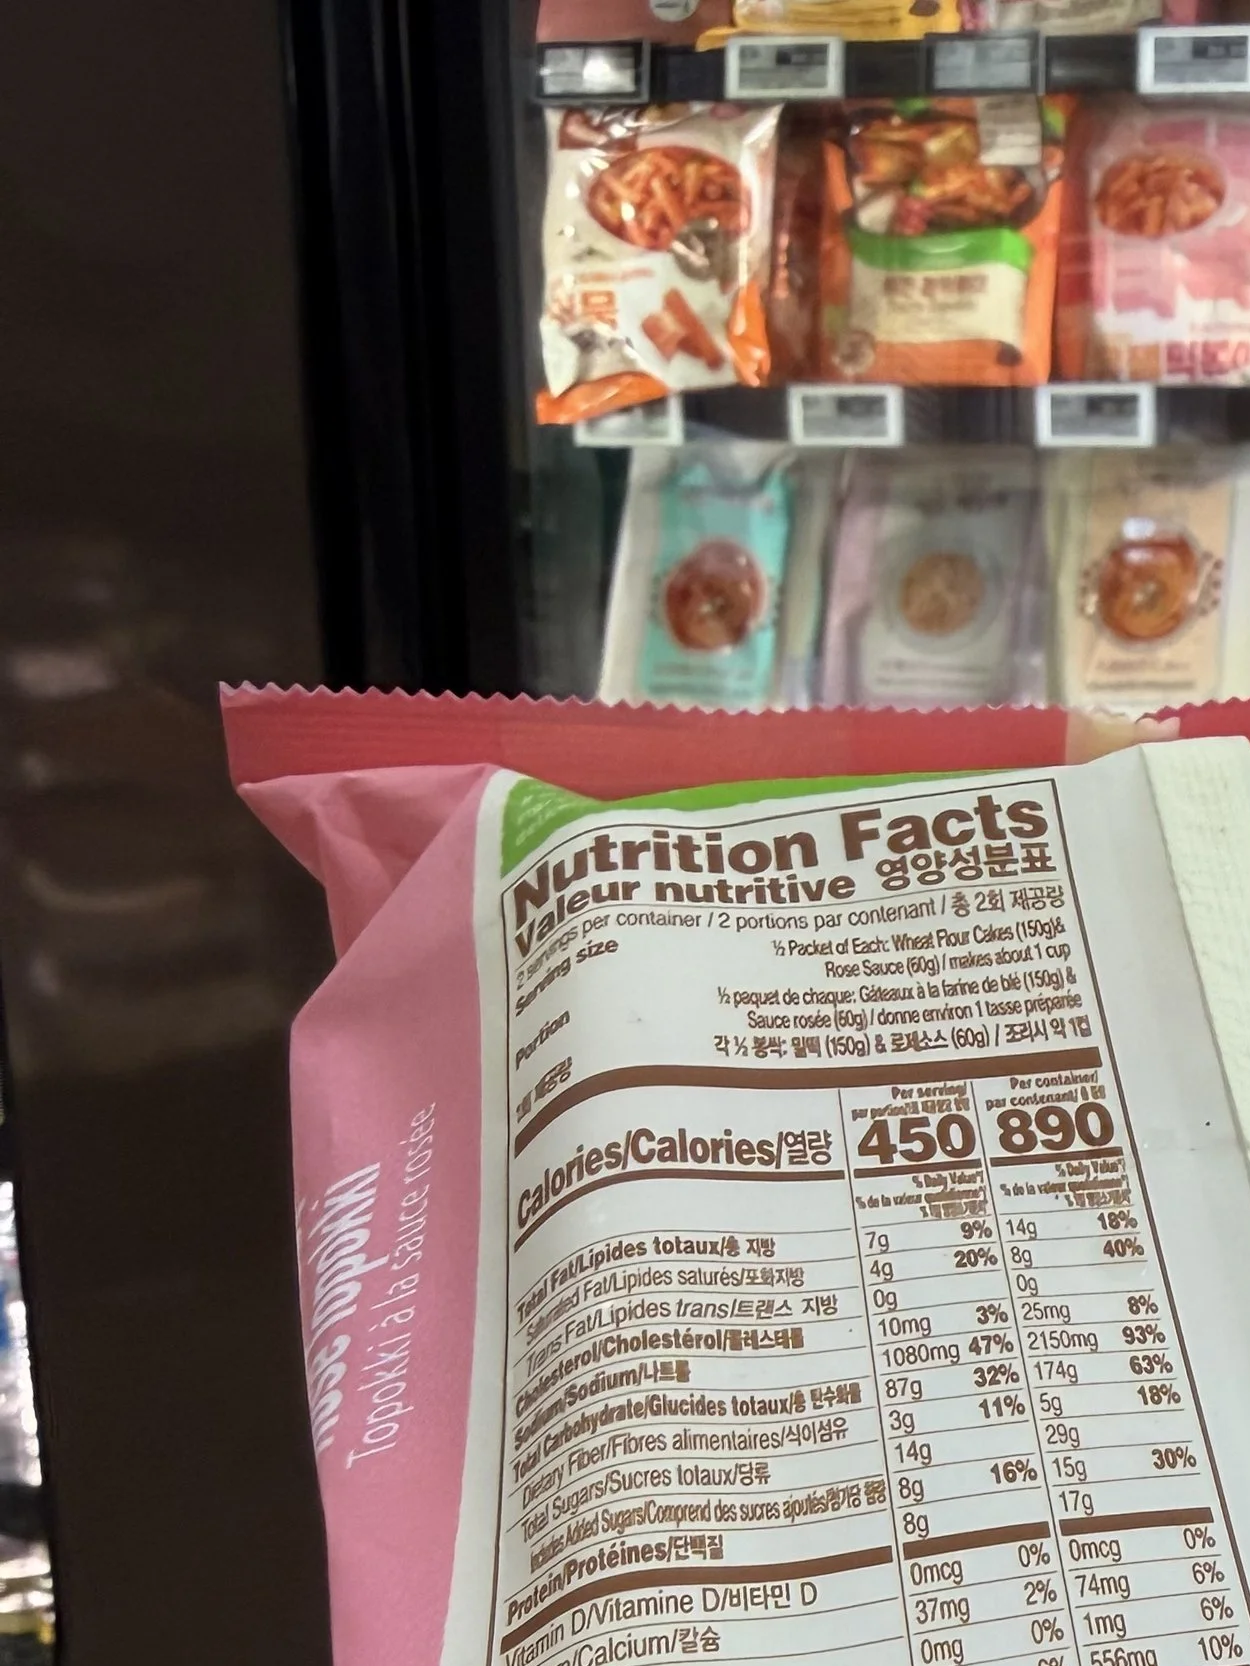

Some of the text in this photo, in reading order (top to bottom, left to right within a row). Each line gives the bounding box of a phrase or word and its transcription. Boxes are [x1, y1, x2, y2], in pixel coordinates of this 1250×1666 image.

[514, 795, 1050, 934] Nutrition Facts
[516, 842, 1057, 958] Valeur nutritive 영양성분표
[857, 1112, 976, 1165] 450
[996, 1101, 1115, 1155] 890
[390, 1184, 431, 1272] sauce
[370, 1271, 420, 1310] la
[881, 1334, 1014, 1367] 1080mg 47%
[1027, 1324, 1166, 1356] 2150mg 93%
[346, 1333, 415, 1470] Topokki
[898, 1461, 1038, 1501] 8g 16%
[1052, 1448, 1197, 1480] 15g 30%
[1074, 1562, 1225, 1599] 74mg 6%
[571, 1589, 694, 1639] D/Vitamine
[703, 1584, 791, 1612] D/비타민
[799, 1582, 818, 1605] D
[915, 1580, 1057, 1625] 37mg 2%
[1197, 1637, 1243, 1661] 10%
